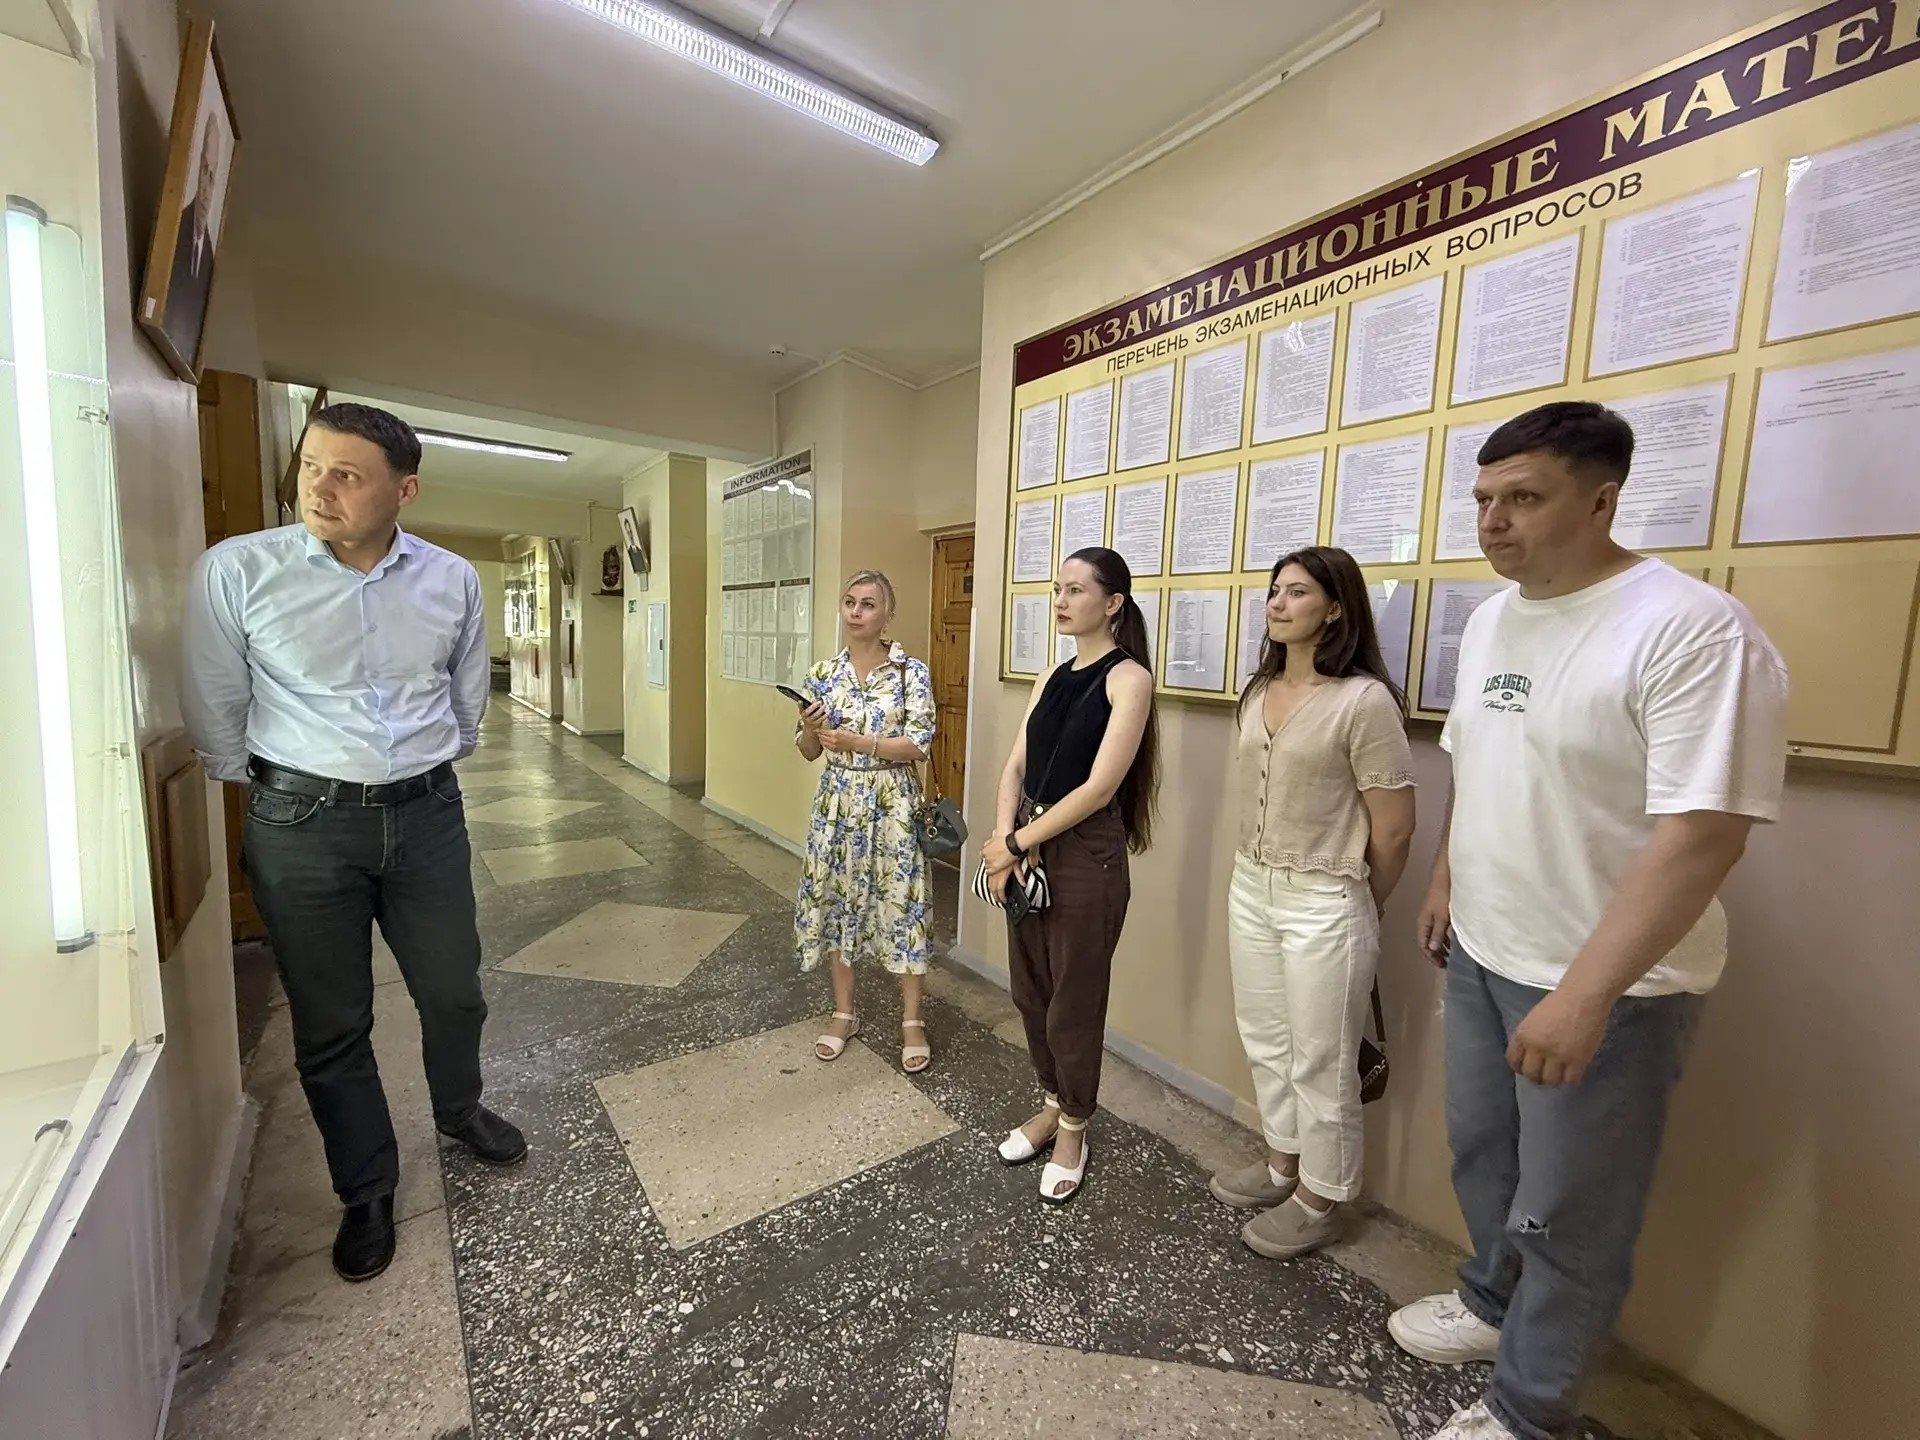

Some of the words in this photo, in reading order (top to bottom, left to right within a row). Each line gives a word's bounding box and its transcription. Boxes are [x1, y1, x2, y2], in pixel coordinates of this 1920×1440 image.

[1062, 138, 1560, 362] ЭКЗАМЕНАЦИОННЫЕ
[1106, 333, 1189, 373] ПЕРЕЧЕНЬ
[1195, 246, 1432, 343] ЭКЗАМЕНАЦИОННЫХ
[1446, 172, 1643, 259] ВОПРОСОВ
[730, 457, 801, 490] INFORMATION
[1482, 674, 1502, 693] LOS
